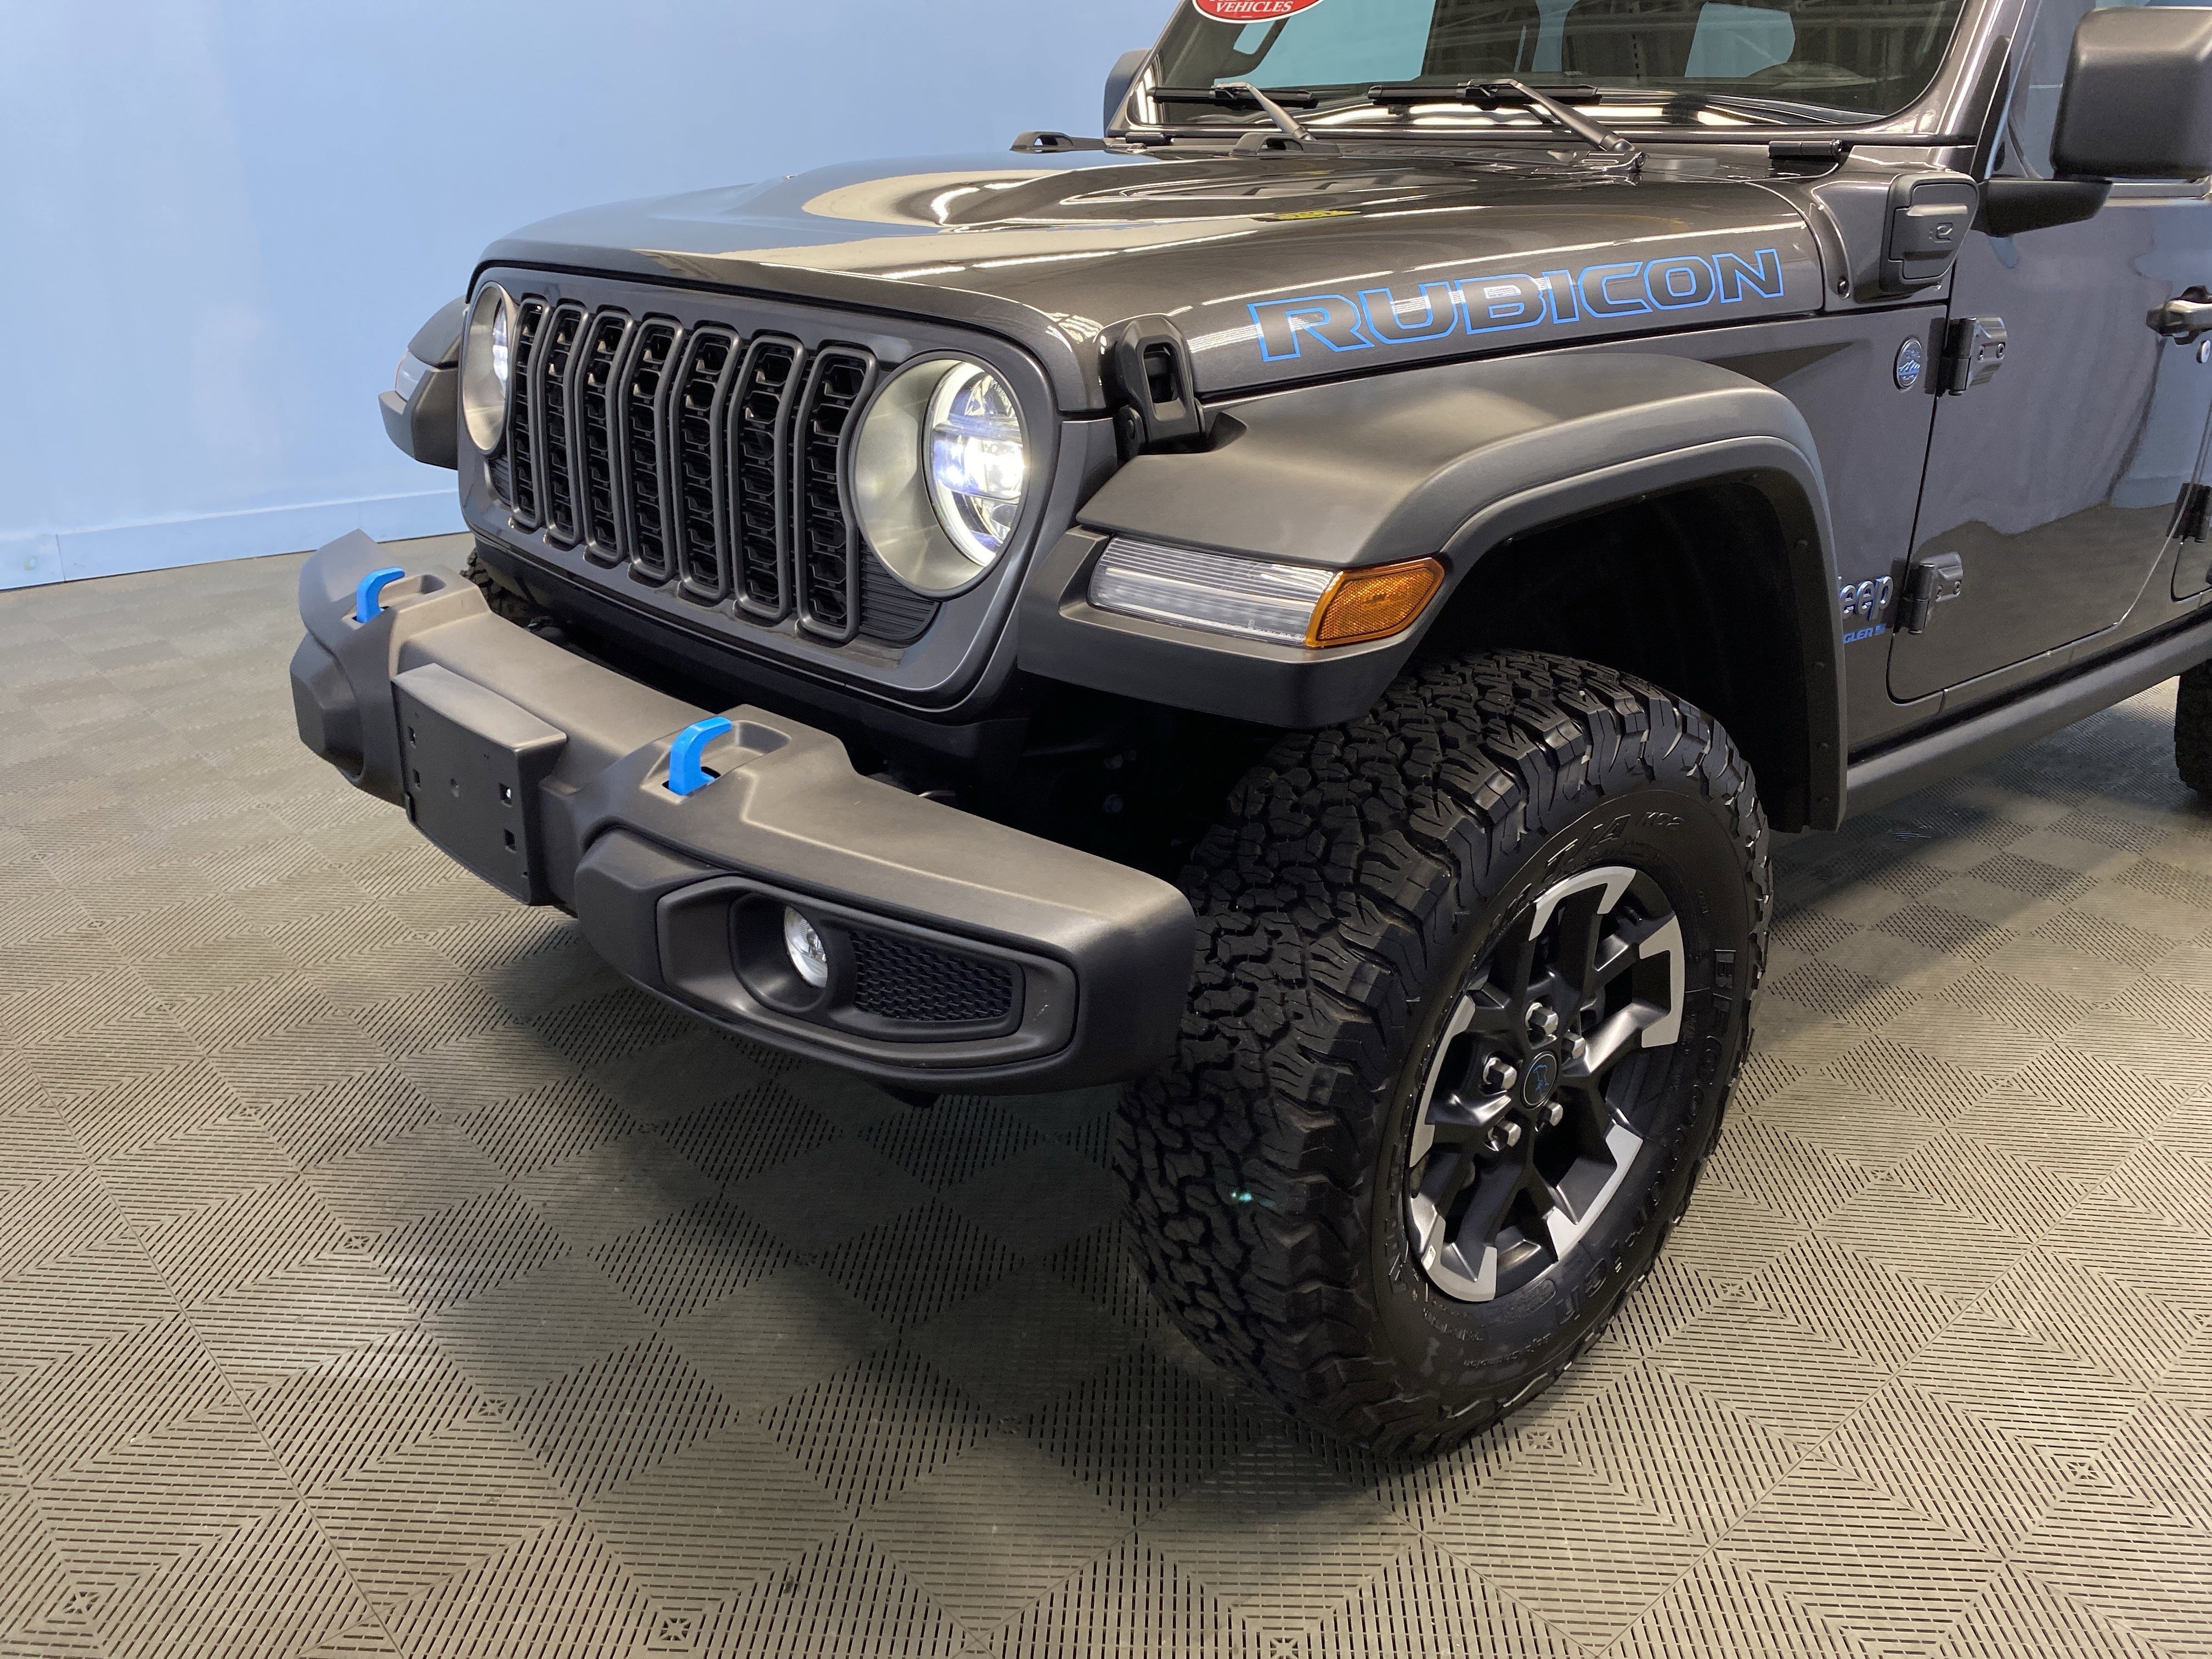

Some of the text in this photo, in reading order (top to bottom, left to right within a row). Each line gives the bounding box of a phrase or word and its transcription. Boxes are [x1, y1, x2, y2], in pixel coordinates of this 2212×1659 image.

[1215, 1, 1294, 12] VEHICLES
[1247, 249, 1784, 362] RUBICON
[1838, 576, 1893, 620] eep
[1842, 627, 1874, 644] GLER
